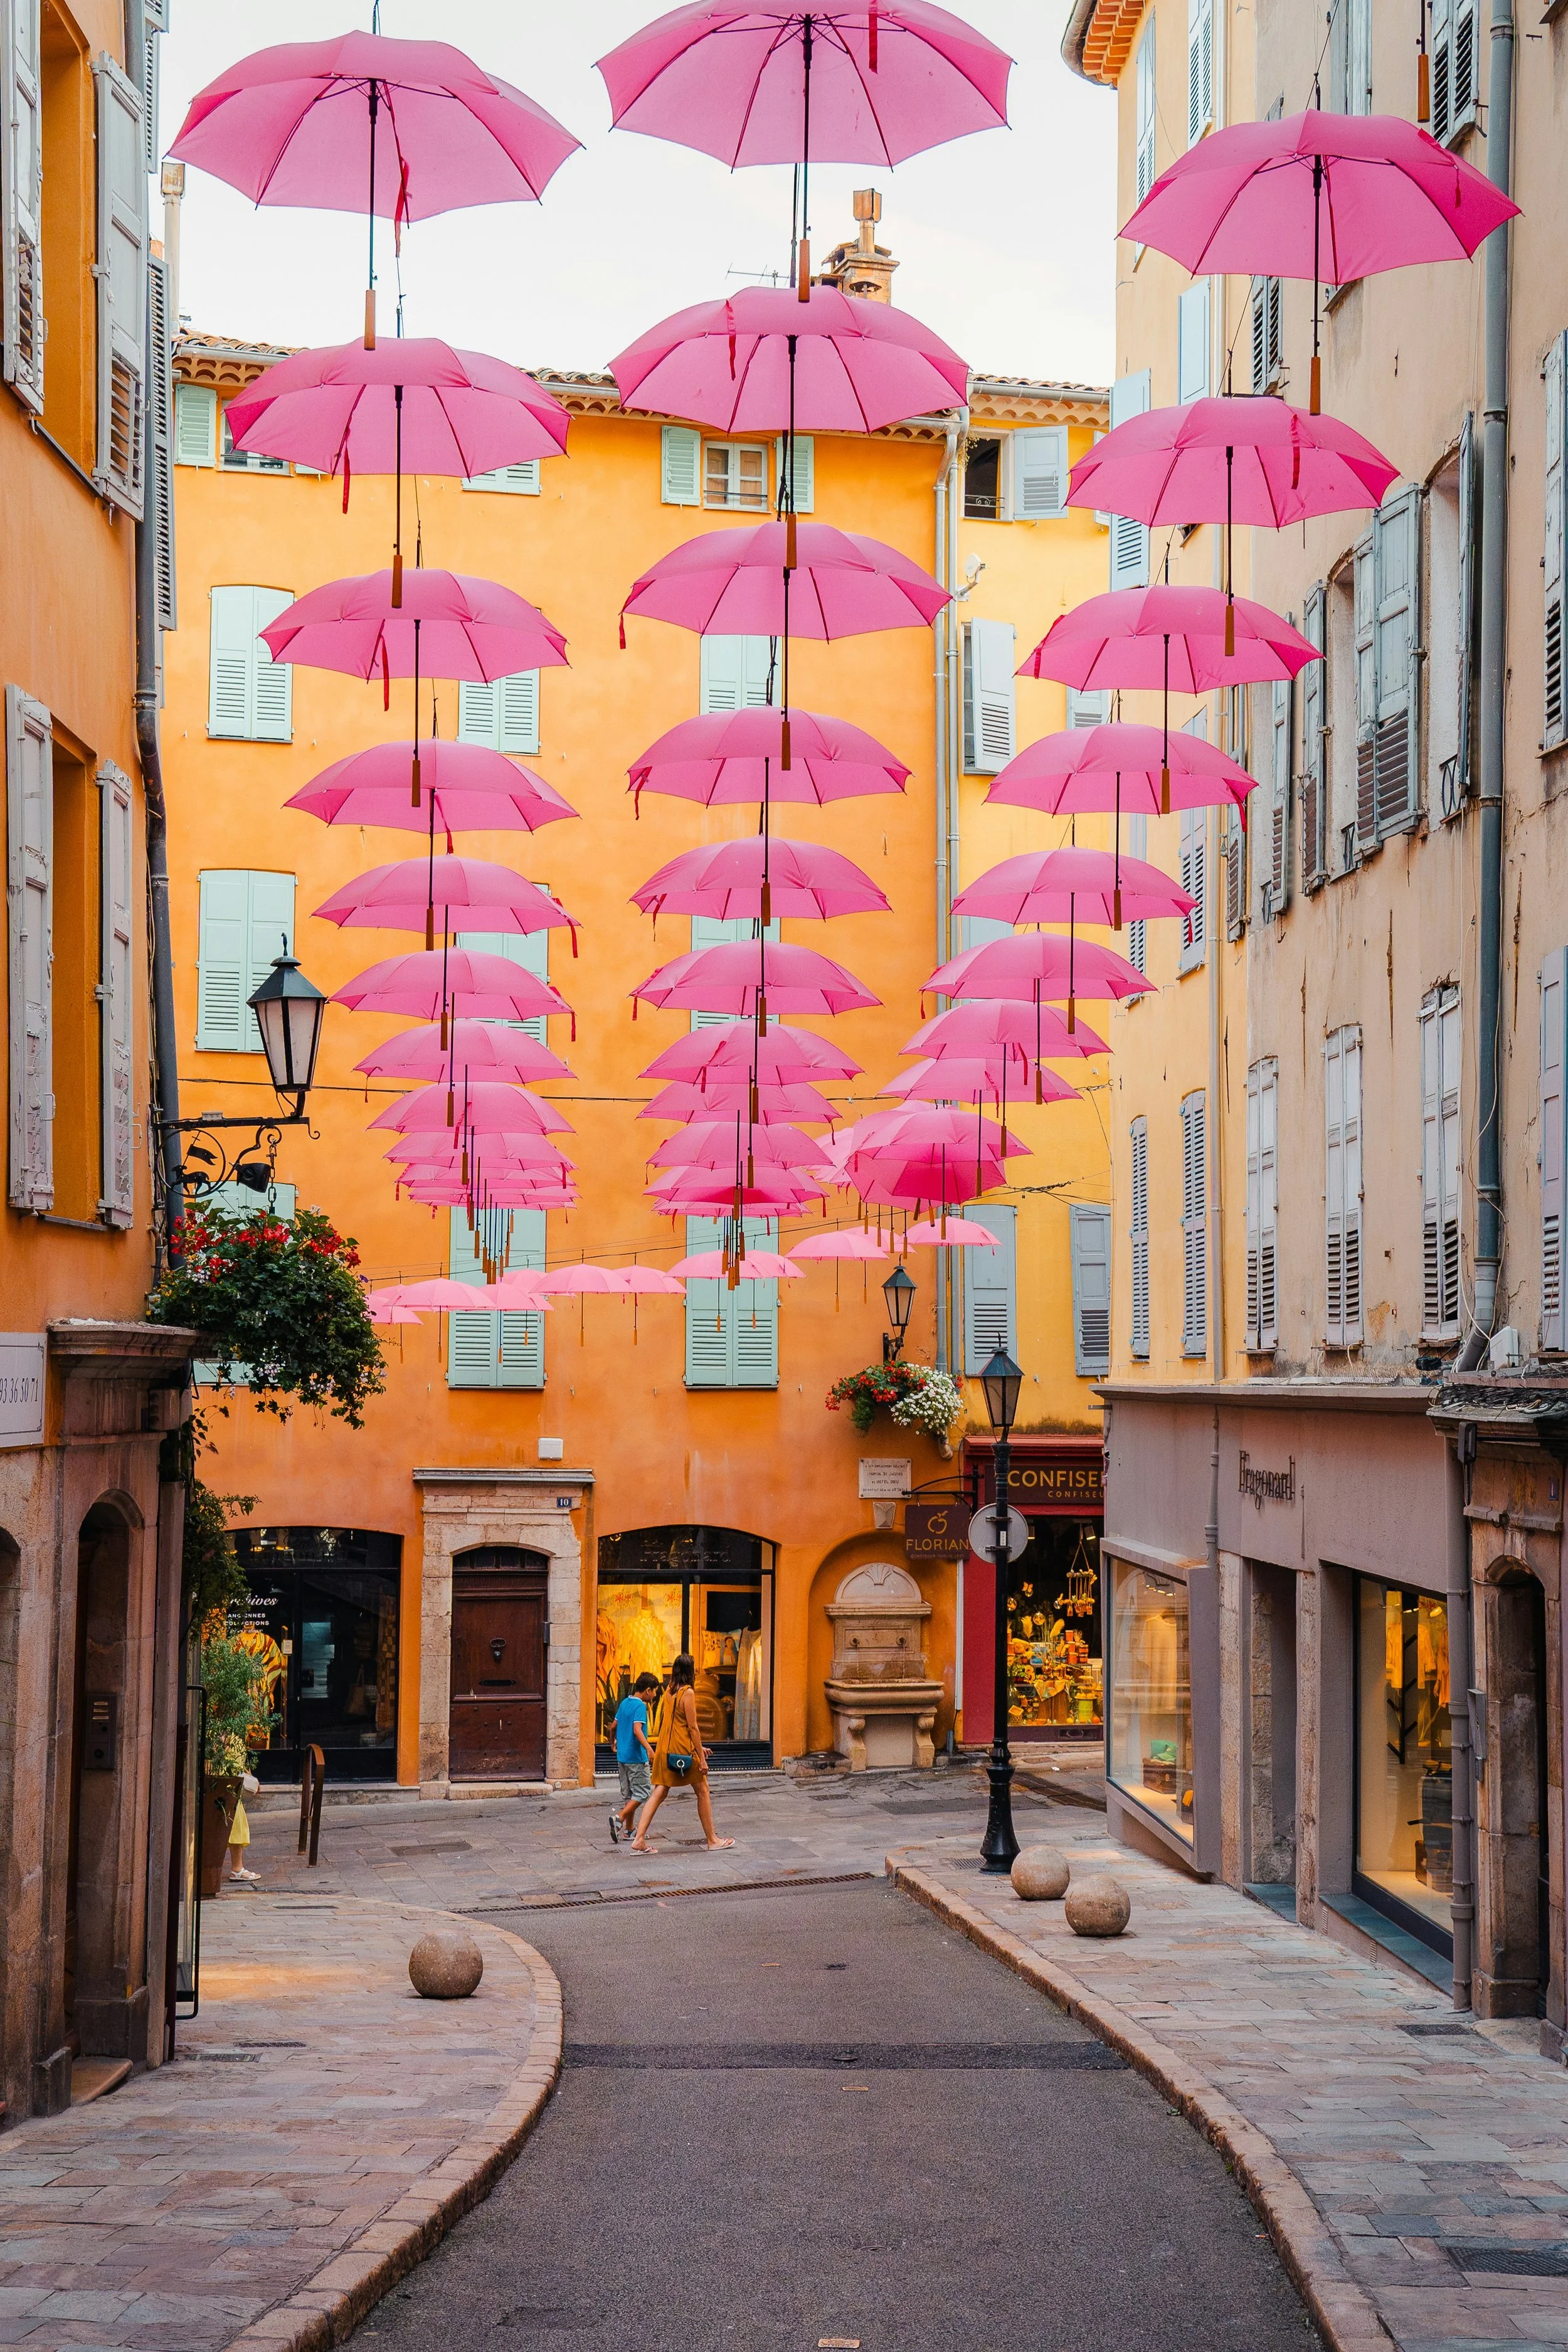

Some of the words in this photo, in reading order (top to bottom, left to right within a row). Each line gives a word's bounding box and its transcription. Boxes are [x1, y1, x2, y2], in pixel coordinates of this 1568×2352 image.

[9, 1378, 18, 1403] 36
[20, 1378, 29, 1402] 50
[31, 1378, 38, 1402] 71
[1239, 1450, 1295, 1510] Fragonard
[906, 1539, 969, 1550] FLORIAN
